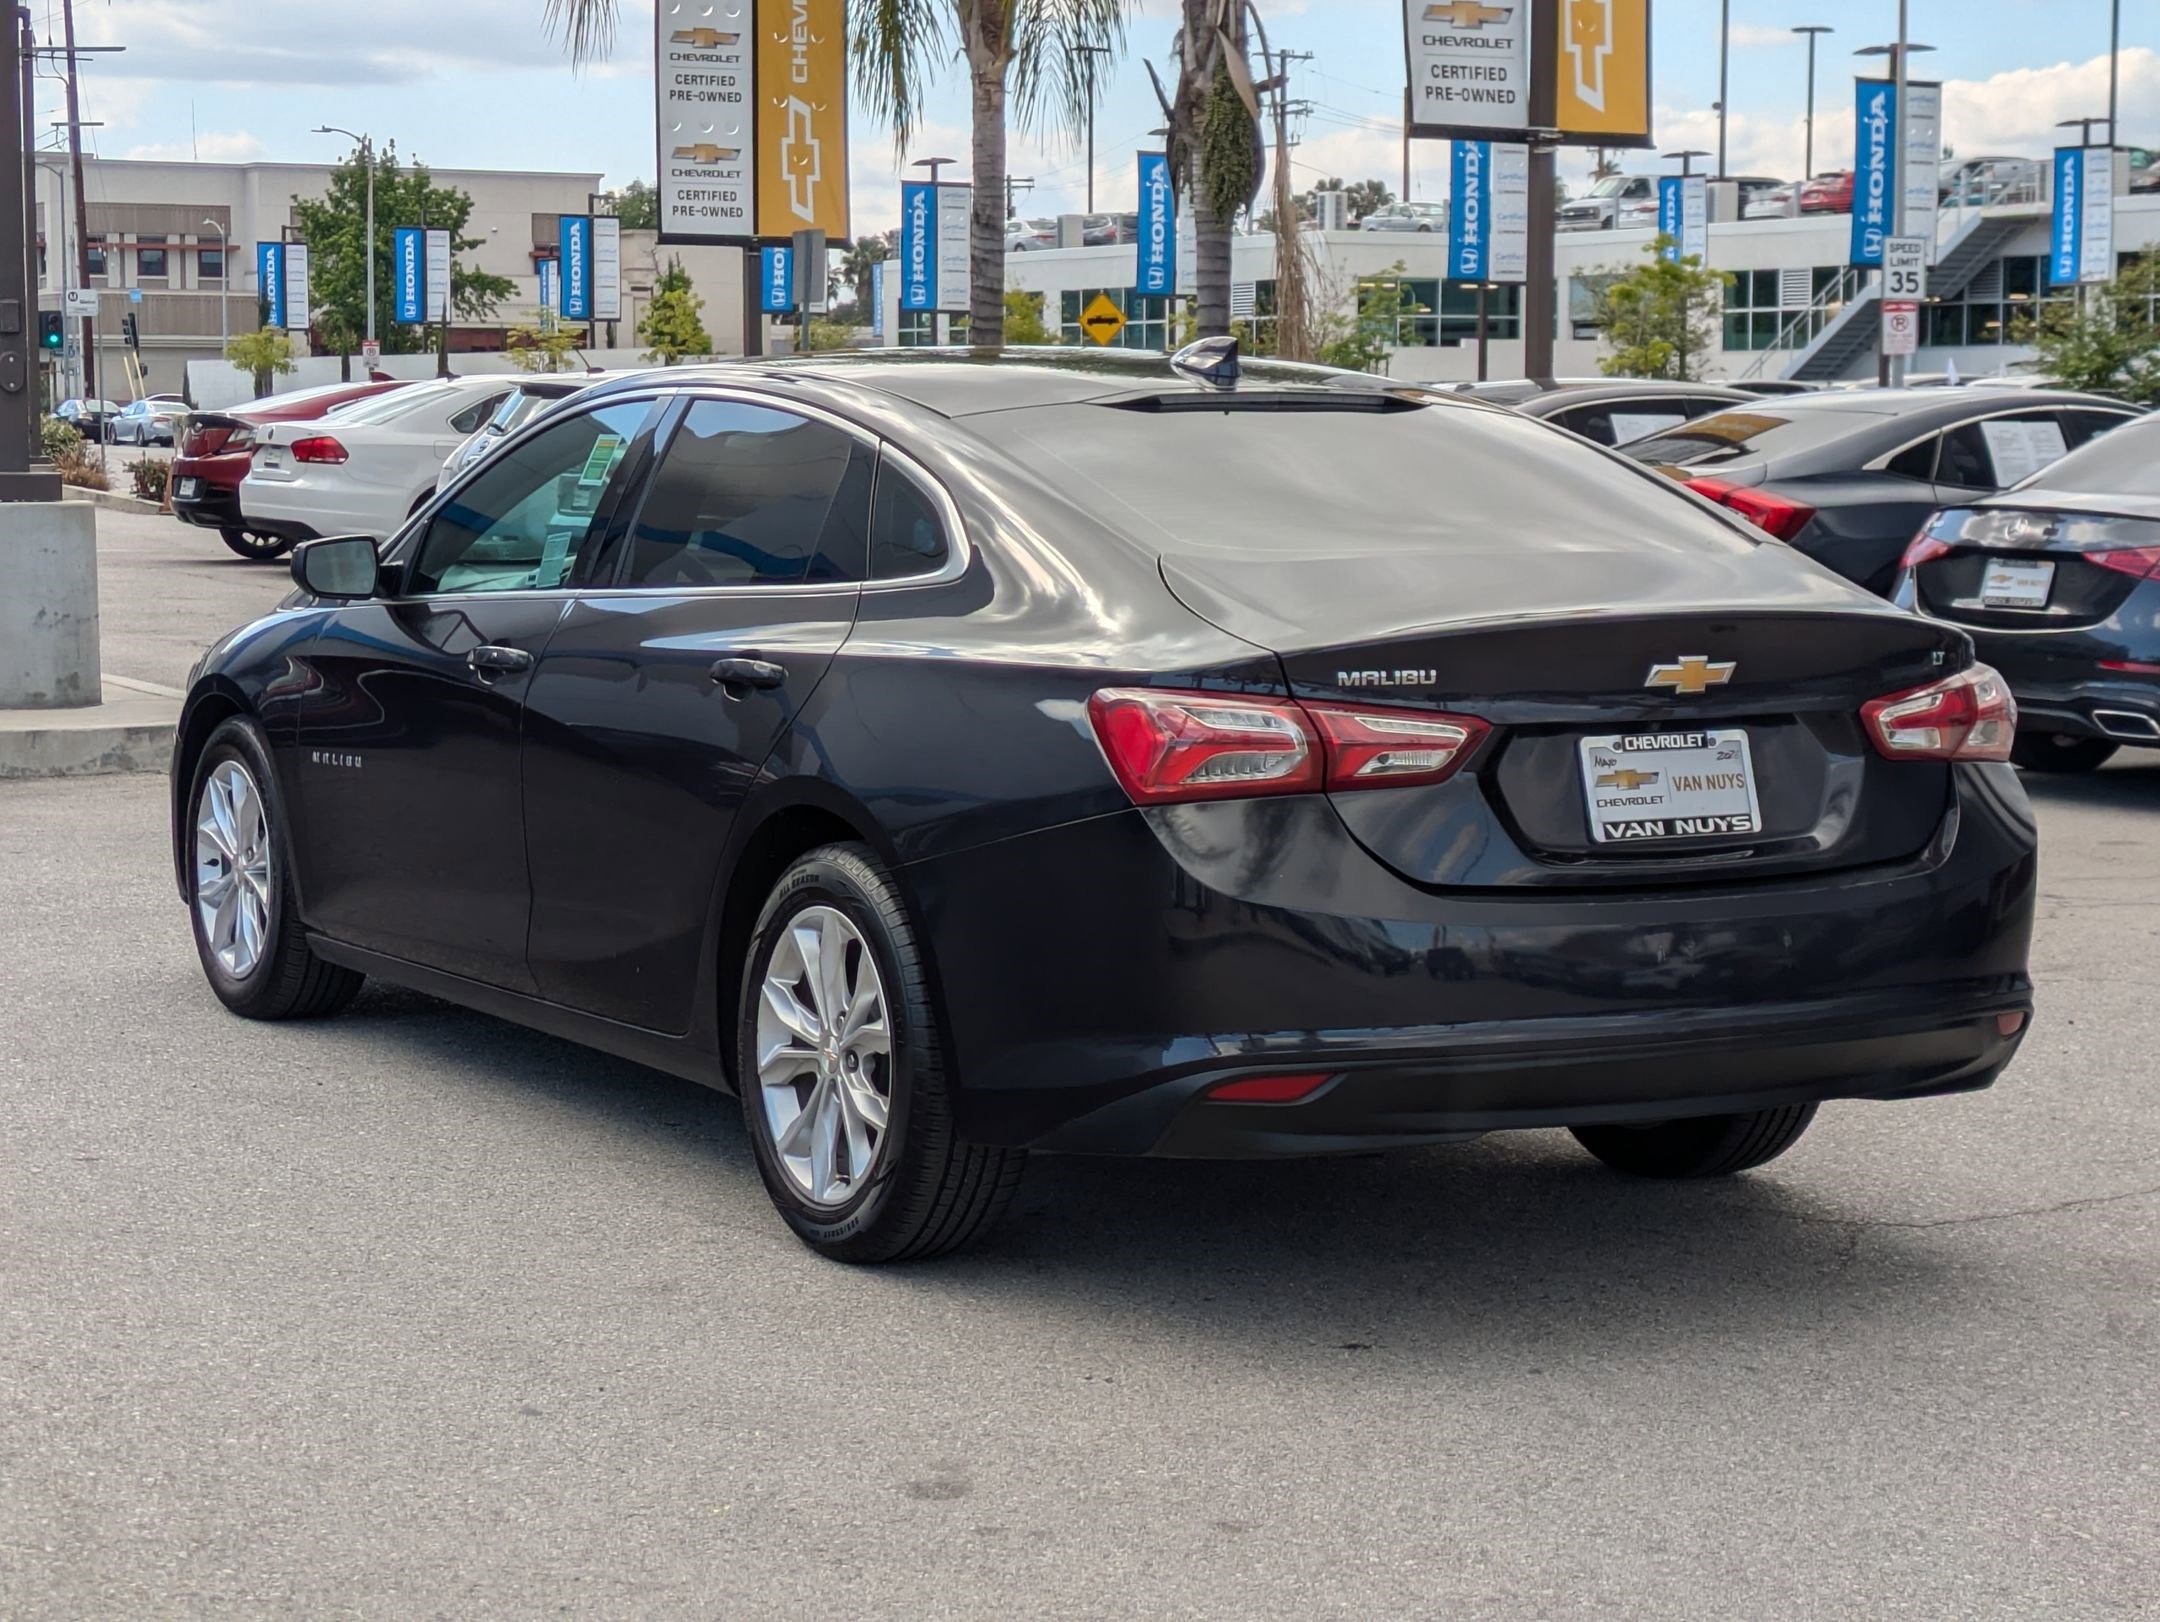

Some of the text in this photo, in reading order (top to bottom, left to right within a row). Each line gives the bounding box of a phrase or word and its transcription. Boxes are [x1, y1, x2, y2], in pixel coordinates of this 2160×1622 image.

[1422, 35, 1514, 49] CHEVROLET
[669, 52, 741, 63] CHEVROLET
[675, 73, 736, 86] CERTIFIED
[1431, 64, 1507, 81] CERTIFIED
[669, 90, 742, 103] PRE-OWNED
[1425, 86, 1516, 104] PRE-OWNED
[1867, 90, 1886, 225] HONDA
[671, 168, 741, 179] CHEVROLET
[677, 189, 737, 202] CERTIFIED
[672, 205, 743, 218] PRE-OWNED
[1151, 160, 1165, 264] HONDA
[2061, 155, 2075, 254] HONDA
[913, 190, 925, 282] HONDA
[1889, 243, 1921, 254] SPEED
[405, 232, 415, 302] HONDA
[570, 221, 581, 296] HONDA
[1889, 257, 1920, 267] LIMIT
[1890, 271, 1919, 294] 35
[1337, 669, 1437, 687] MALIBU
[1624, 733, 1705, 751] CHEVROLET
[312, 751, 362, 768] MALIBU
[1672, 772, 1745, 792] VAN NUYS
[1596, 795, 1665, 808] CHEVROLET
[1605, 815, 1751, 838] VAN NUYS
